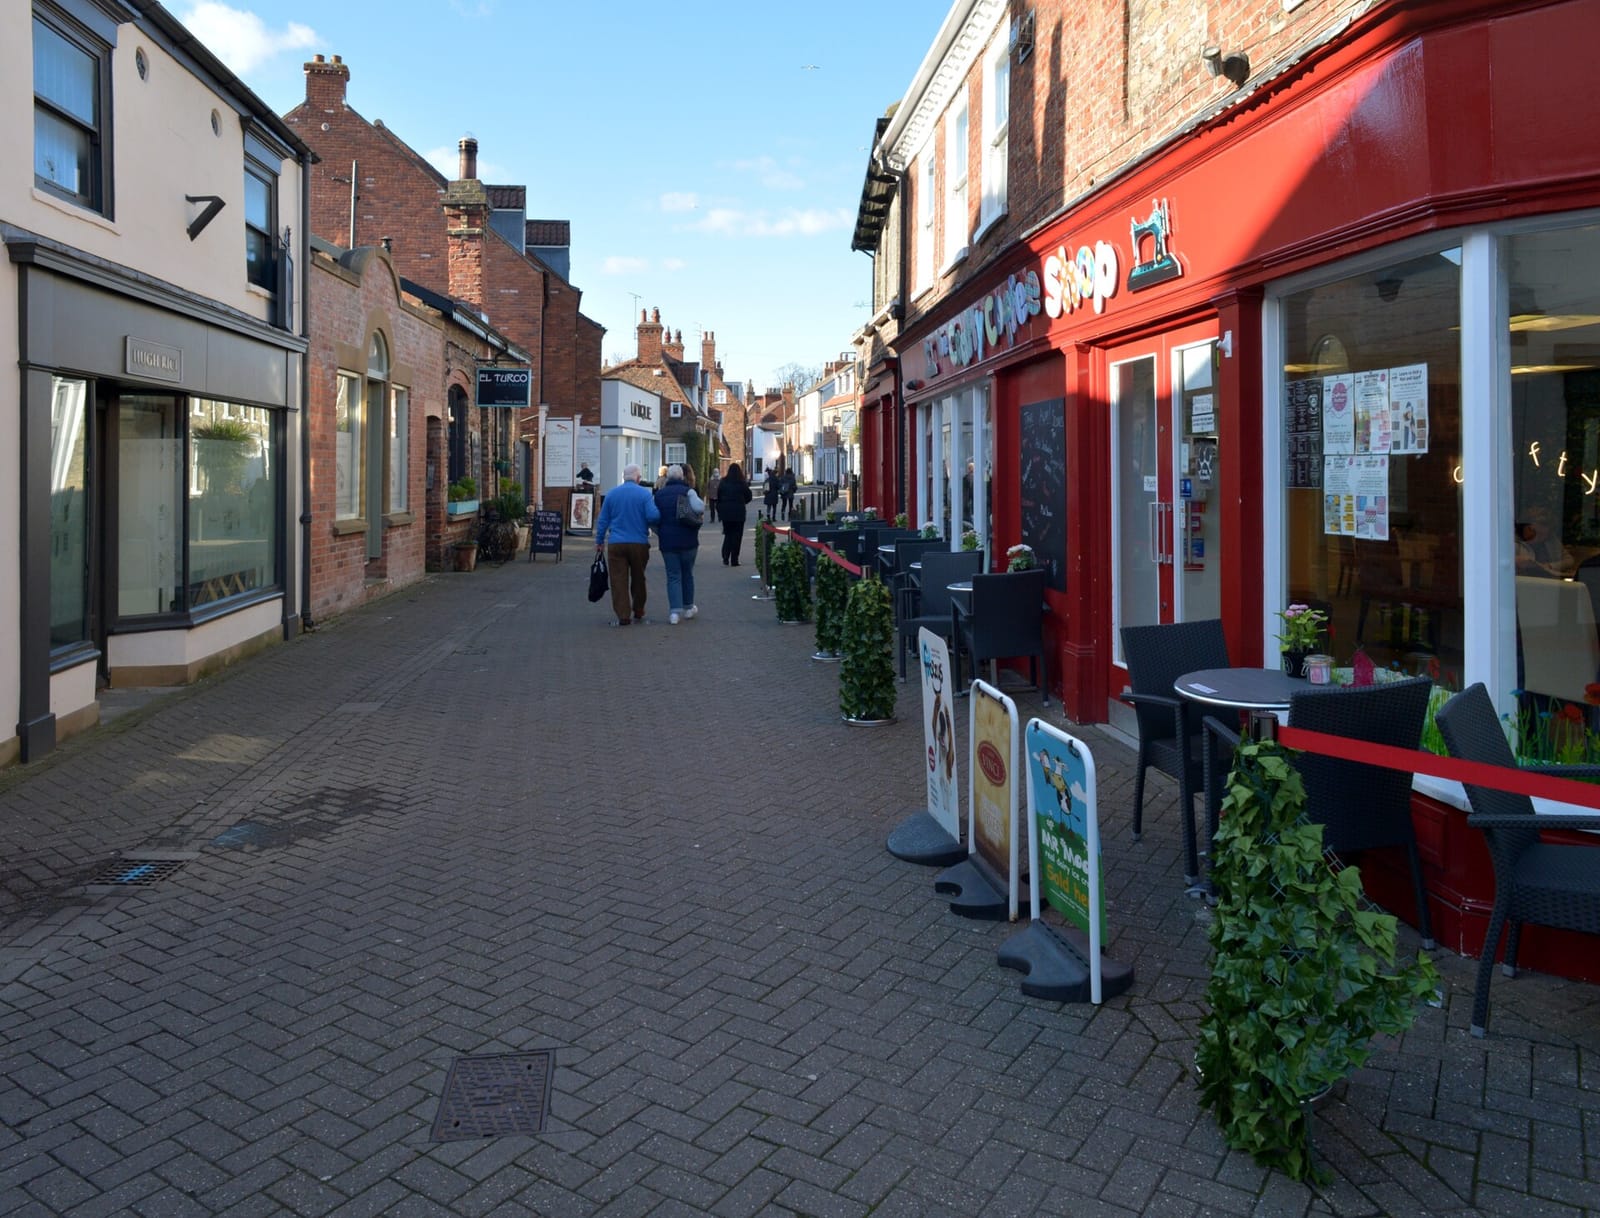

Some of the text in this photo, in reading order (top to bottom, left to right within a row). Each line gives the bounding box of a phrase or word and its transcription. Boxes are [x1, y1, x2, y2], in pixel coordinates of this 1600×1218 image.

[1044, 239, 1118, 319] Shop
[133, 349, 160, 368] HUGH
[479, 373, 528, 383] EL TURCO
[1046, 864, 1070, 894] Sold
